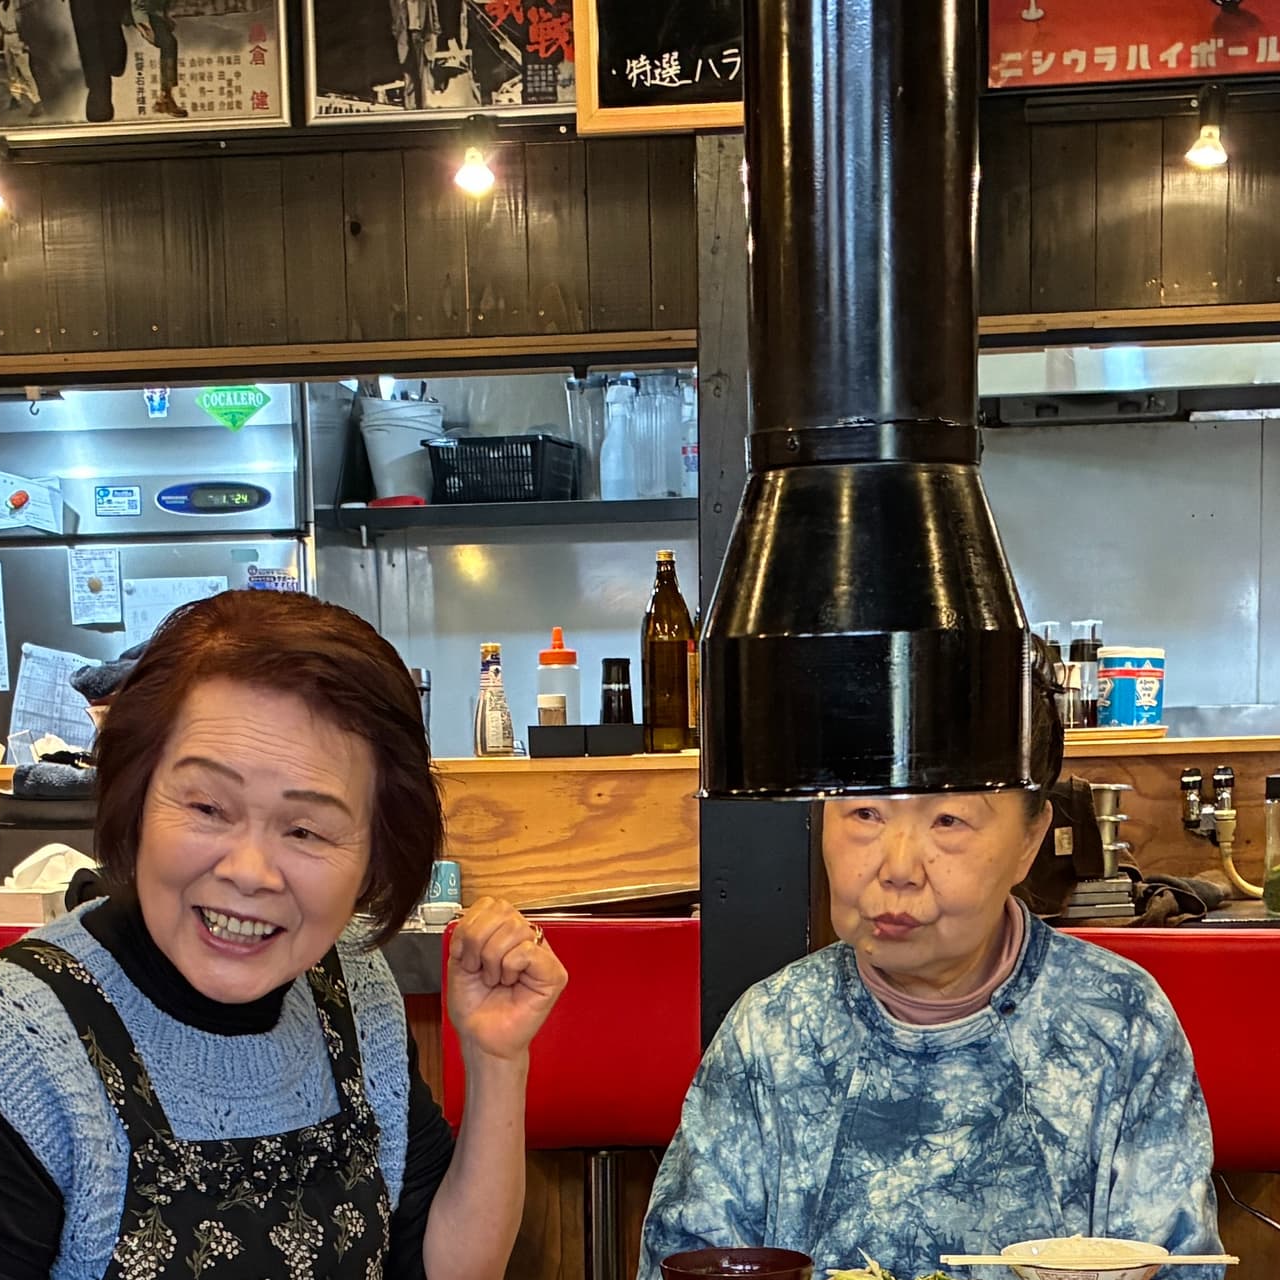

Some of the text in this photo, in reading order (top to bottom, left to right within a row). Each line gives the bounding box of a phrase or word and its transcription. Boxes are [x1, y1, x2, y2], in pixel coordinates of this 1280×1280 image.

[1000, 36, 1280, 78] ニシウラハイボール
[202, 391, 264, 408] COCALERO
